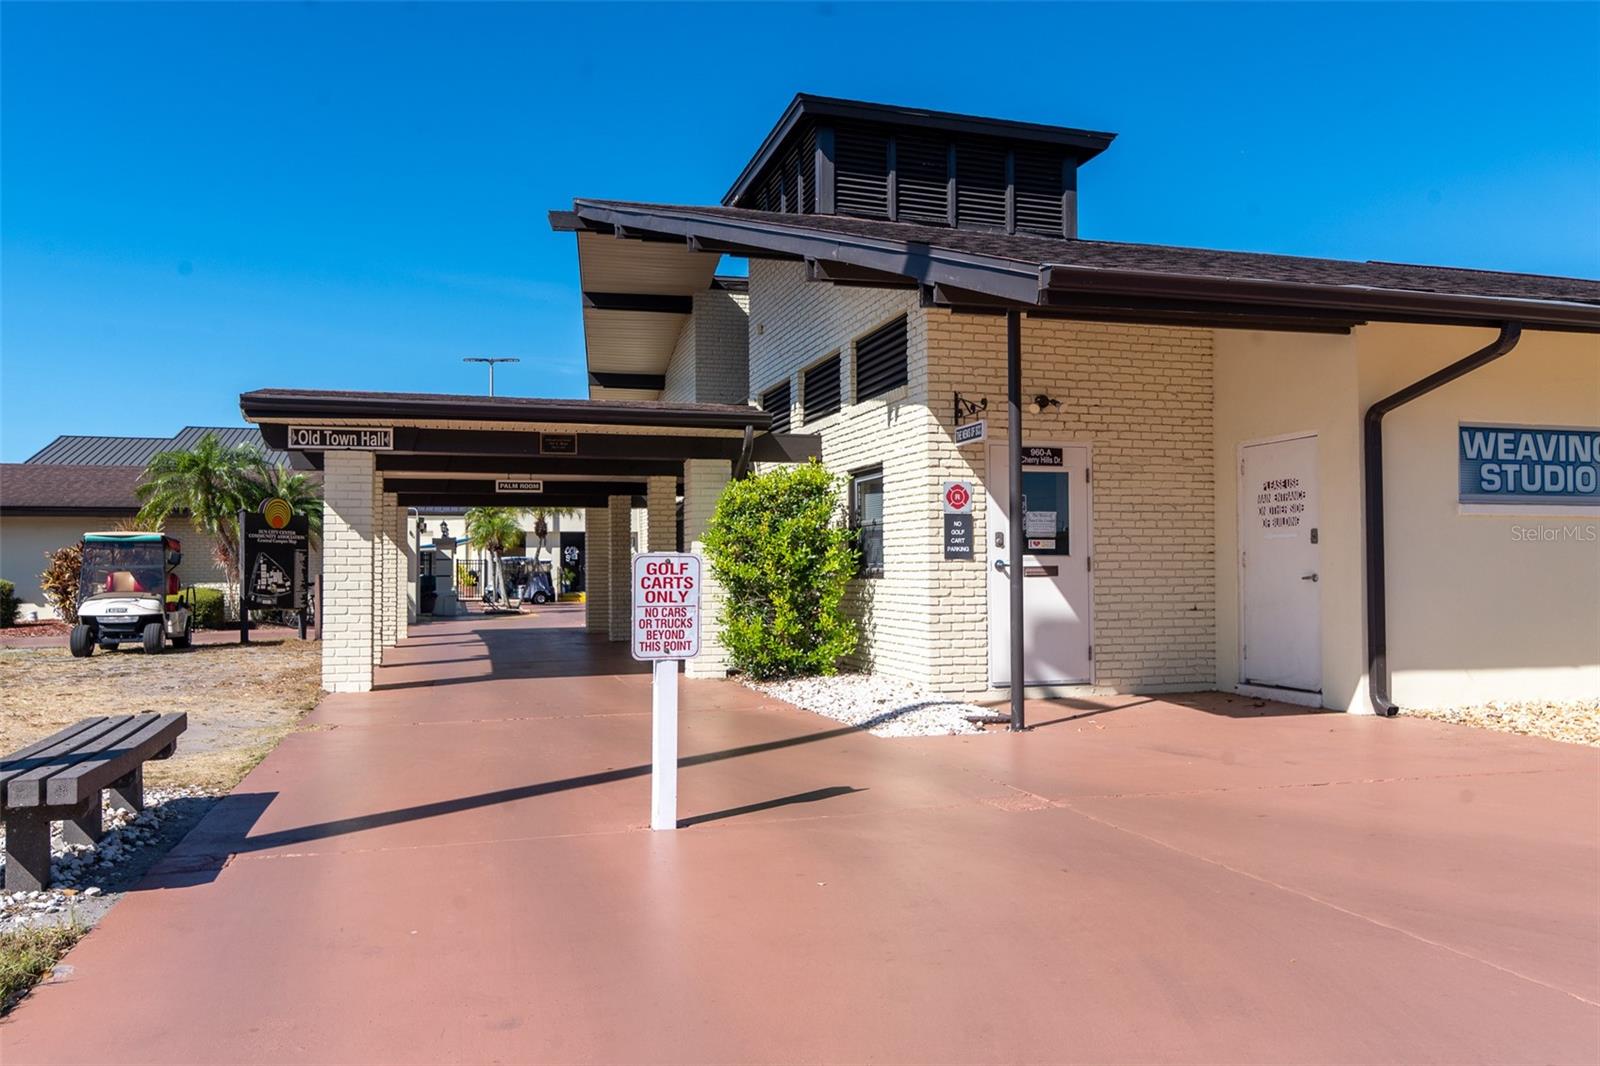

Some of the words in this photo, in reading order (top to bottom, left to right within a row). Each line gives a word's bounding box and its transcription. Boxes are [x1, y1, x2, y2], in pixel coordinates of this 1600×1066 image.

[298, 430, 320, 445] Old
[323, 430, 357, 446] Town
[361, 431, 385, 446] Hall
[1030, 448, 1052, 456] 960-A
[1040, 456, 1053, 464] Hills
[1480, 463, 1597, 493] STUDIO
[646, 562, 689, 575] GOLF
[641, 576, 694, 589] CARTS
[645, 590, 690, 603] ONLY
[645, 607, 659, 618] NO
[661, 607, 687, 618] CARS
[638, 619, 653, 629] OR
[655, 618, 693, 629] TRUCKS
[646, 629, 685, 640] BEYOND
[639, 641, 661, 652] THIS
[663, 640, 693, 652] POINT
